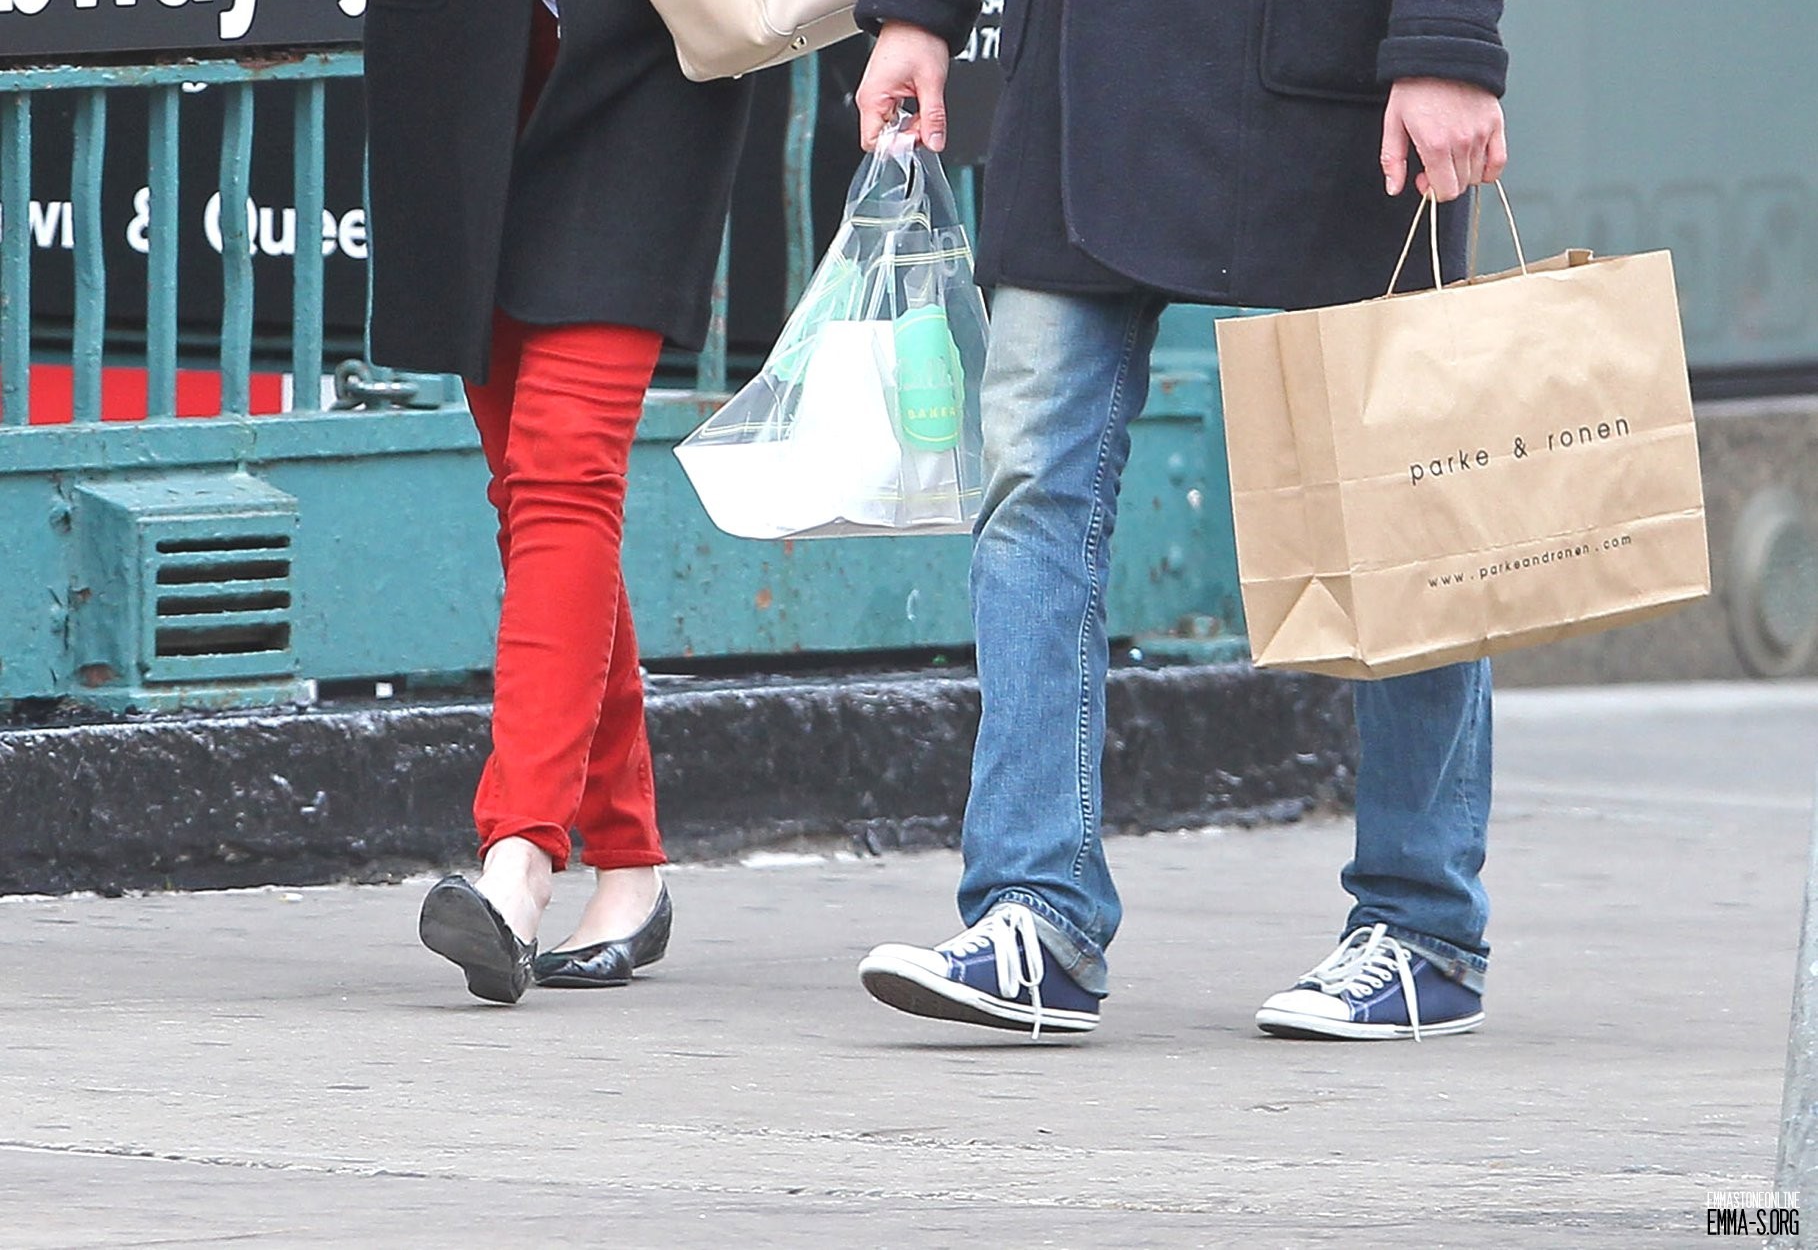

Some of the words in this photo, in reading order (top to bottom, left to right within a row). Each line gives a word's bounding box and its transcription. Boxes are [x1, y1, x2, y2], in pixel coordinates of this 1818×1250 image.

[1409, 449, 1490, 485] parke
[1513, 437, 1528, 459] &
[1548, 418, 1630, 451] ronen
[1428, 533, 1632, 588] www.parkeandronen.com
